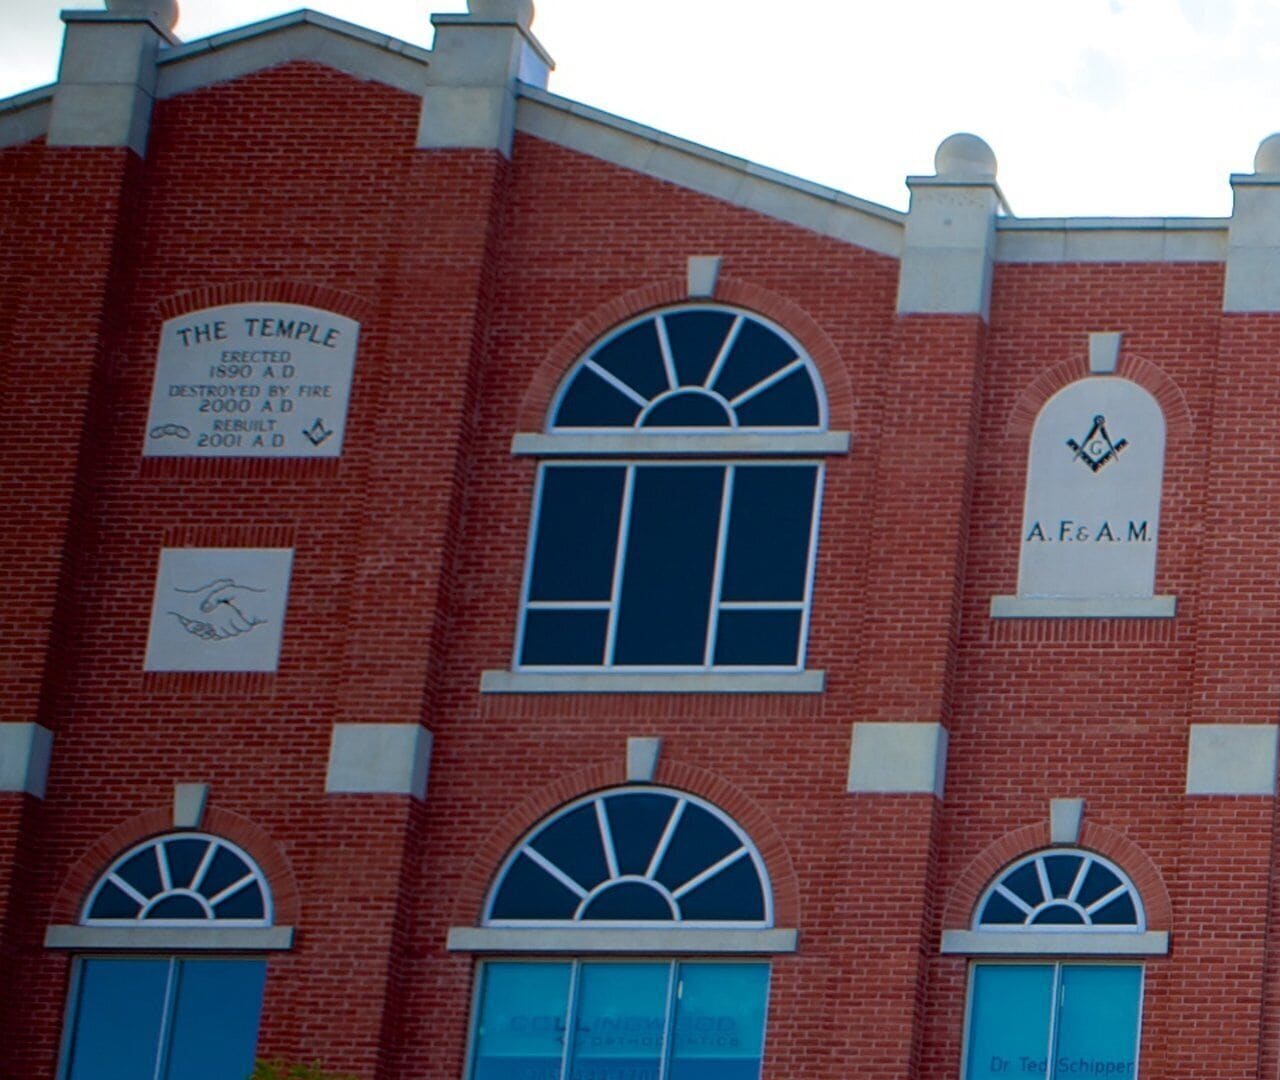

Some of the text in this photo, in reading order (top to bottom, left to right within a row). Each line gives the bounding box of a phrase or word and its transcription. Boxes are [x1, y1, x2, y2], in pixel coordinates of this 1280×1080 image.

[176, 318, 341, 348] THE TEMPLE
[221, 351, 291, 363] ERECTED
[169, 385, 333, 397] DESTROYED BY FIRE
[199, 400, 251, 413] 2000
[213, 419, 277, 431] REBUILT
[197, 434, 242, 447] 2001
[990, 1057, 1134, 1076] Dr Ted Schipper
